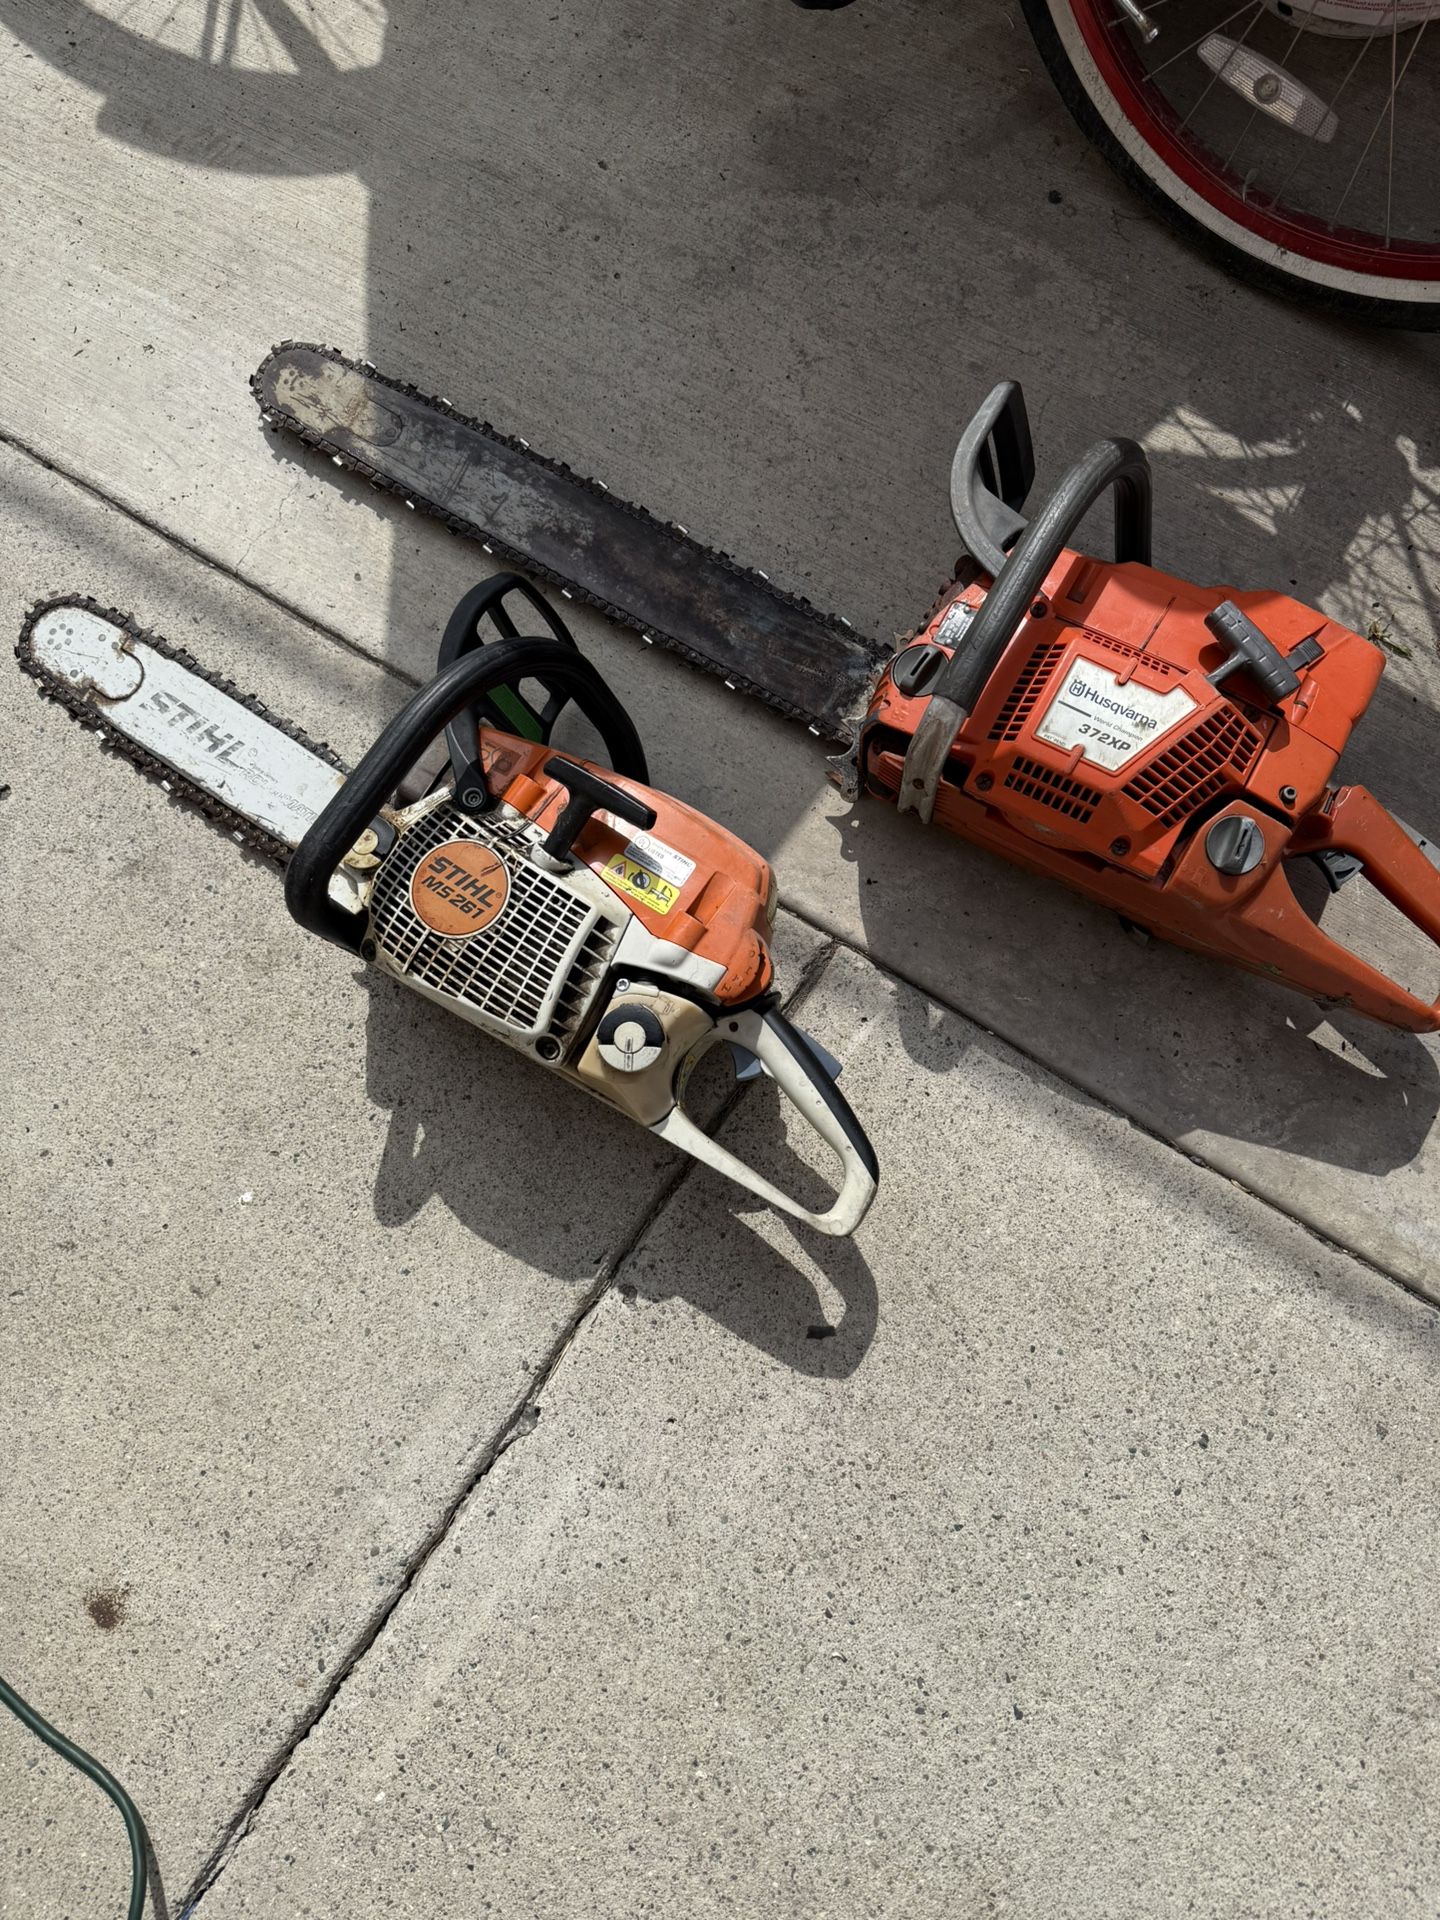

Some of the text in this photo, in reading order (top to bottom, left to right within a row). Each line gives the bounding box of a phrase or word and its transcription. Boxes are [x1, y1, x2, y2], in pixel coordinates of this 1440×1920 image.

[139, 690, 246, 769] STIHL
[1083, 686, 1158, 729] Husqvarna
[1078, 723, 1132, 751] 372XP
[421, 875, 486, 920] MS 261
[427, 855, 496, 909] STIHL
